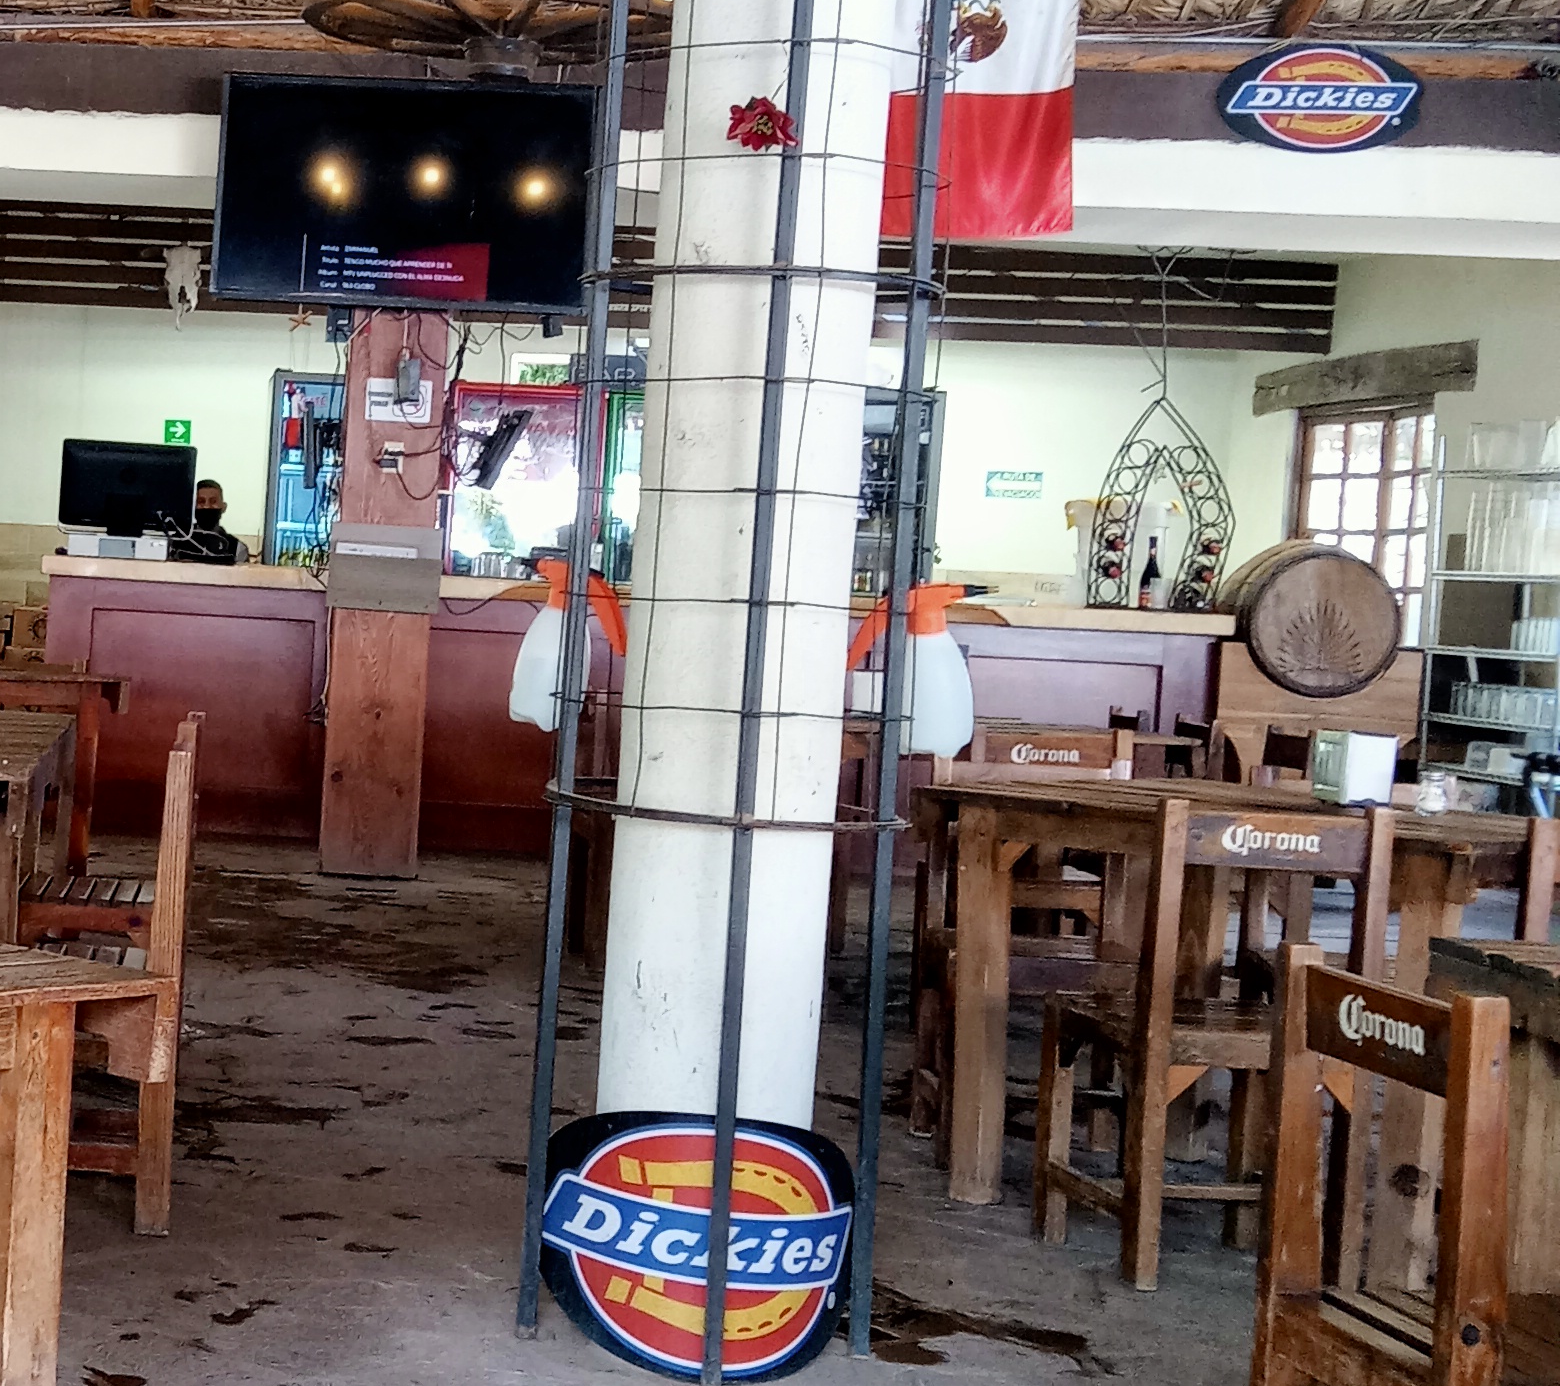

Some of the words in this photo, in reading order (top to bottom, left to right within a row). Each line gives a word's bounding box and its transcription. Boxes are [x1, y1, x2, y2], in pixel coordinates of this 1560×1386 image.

[1246, 86, 1399, 109] Dickies
[1010, 742, 1081, 764] Corona
[1221, 823, 1322, 856] Corona
[1338, 993, 1427, 1057] Corona
[560, 1192, 839, 1275] Dickies
